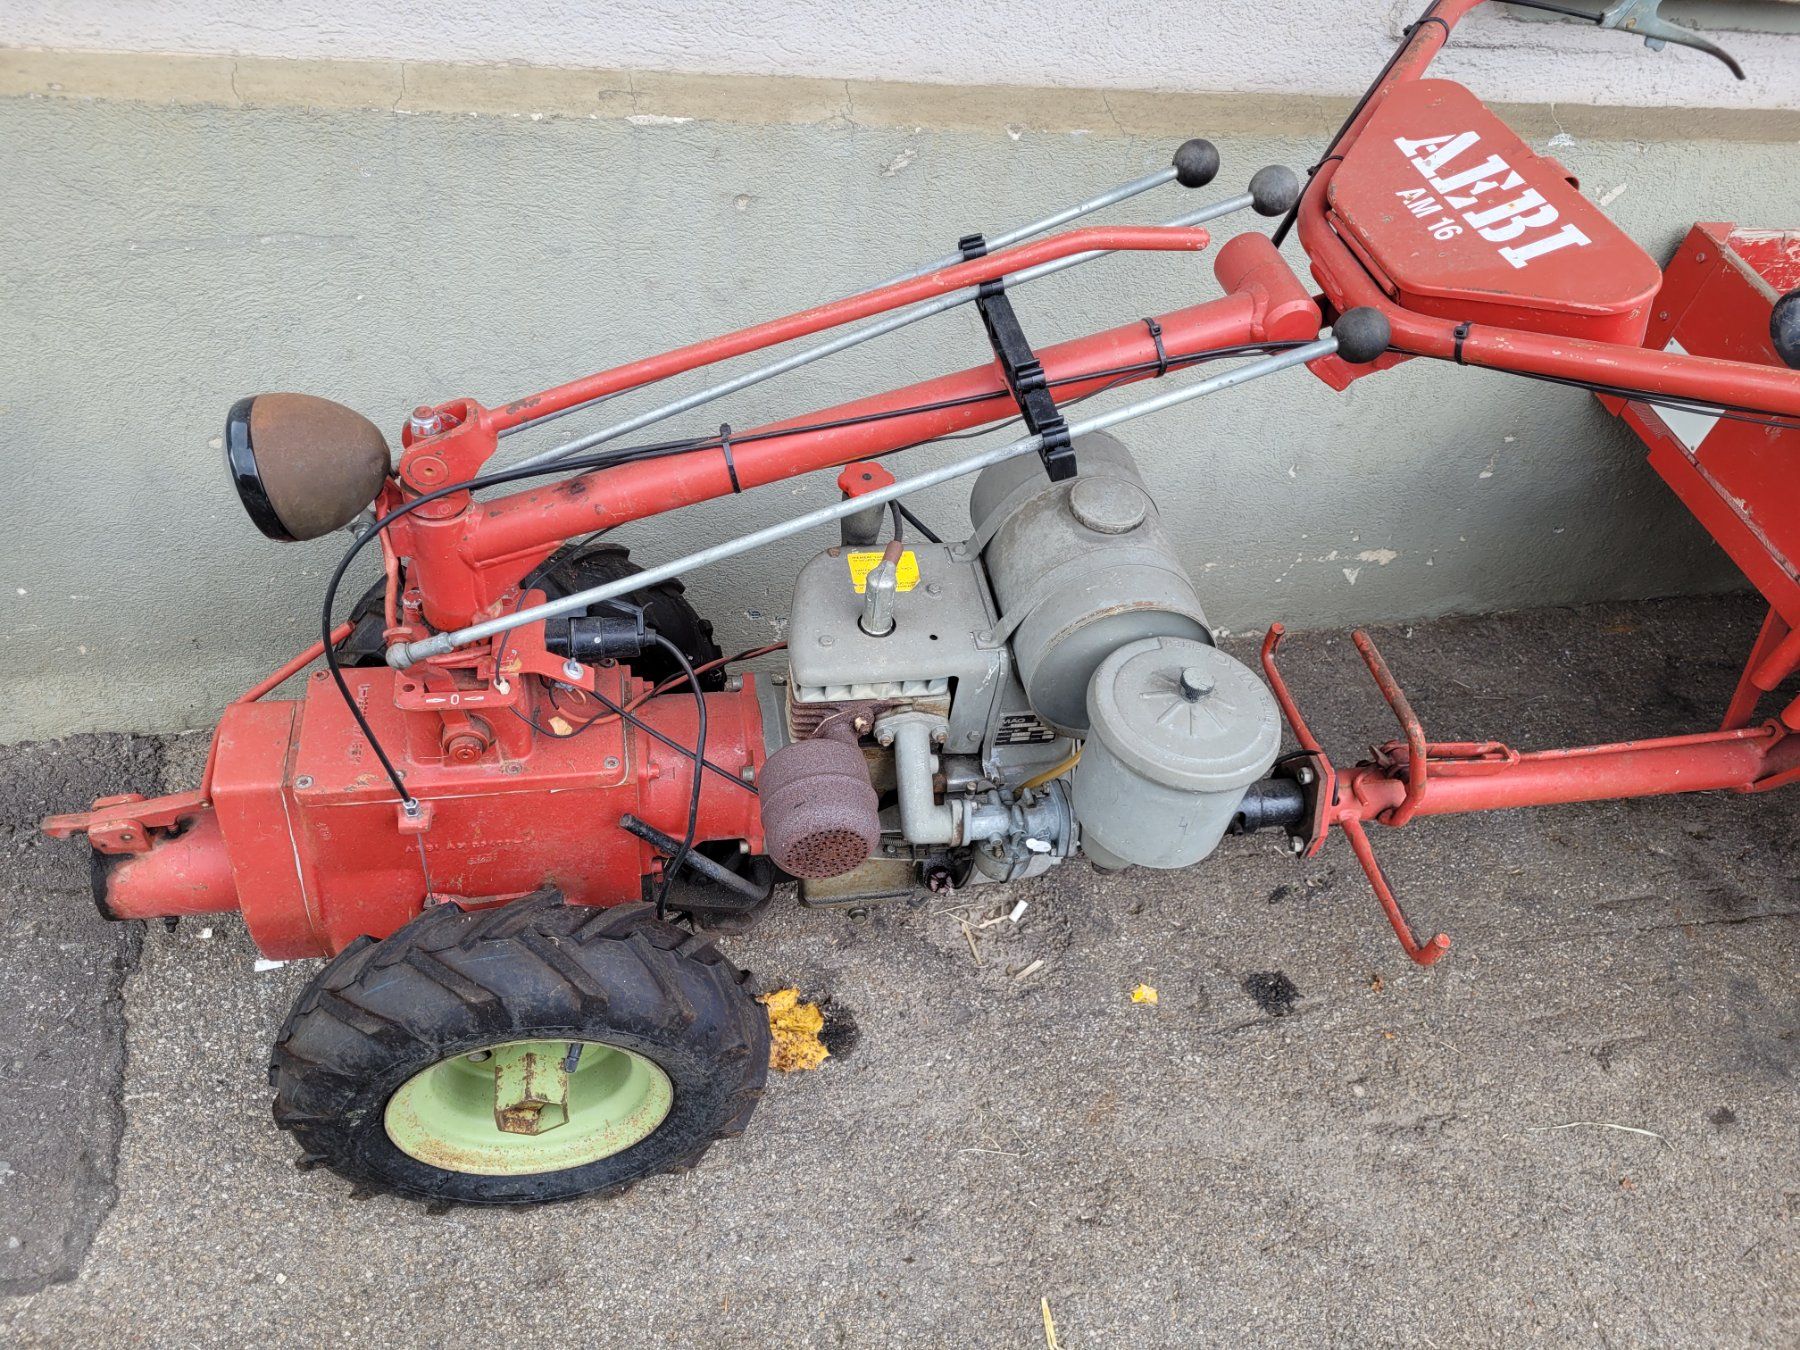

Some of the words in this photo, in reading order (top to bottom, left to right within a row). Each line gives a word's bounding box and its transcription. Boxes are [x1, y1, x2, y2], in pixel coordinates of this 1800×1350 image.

[1394, 131, 1592, 269] AEBI
[1395, 187, 1444, 219] AM
[1427, 216, 1463, 241] 16
